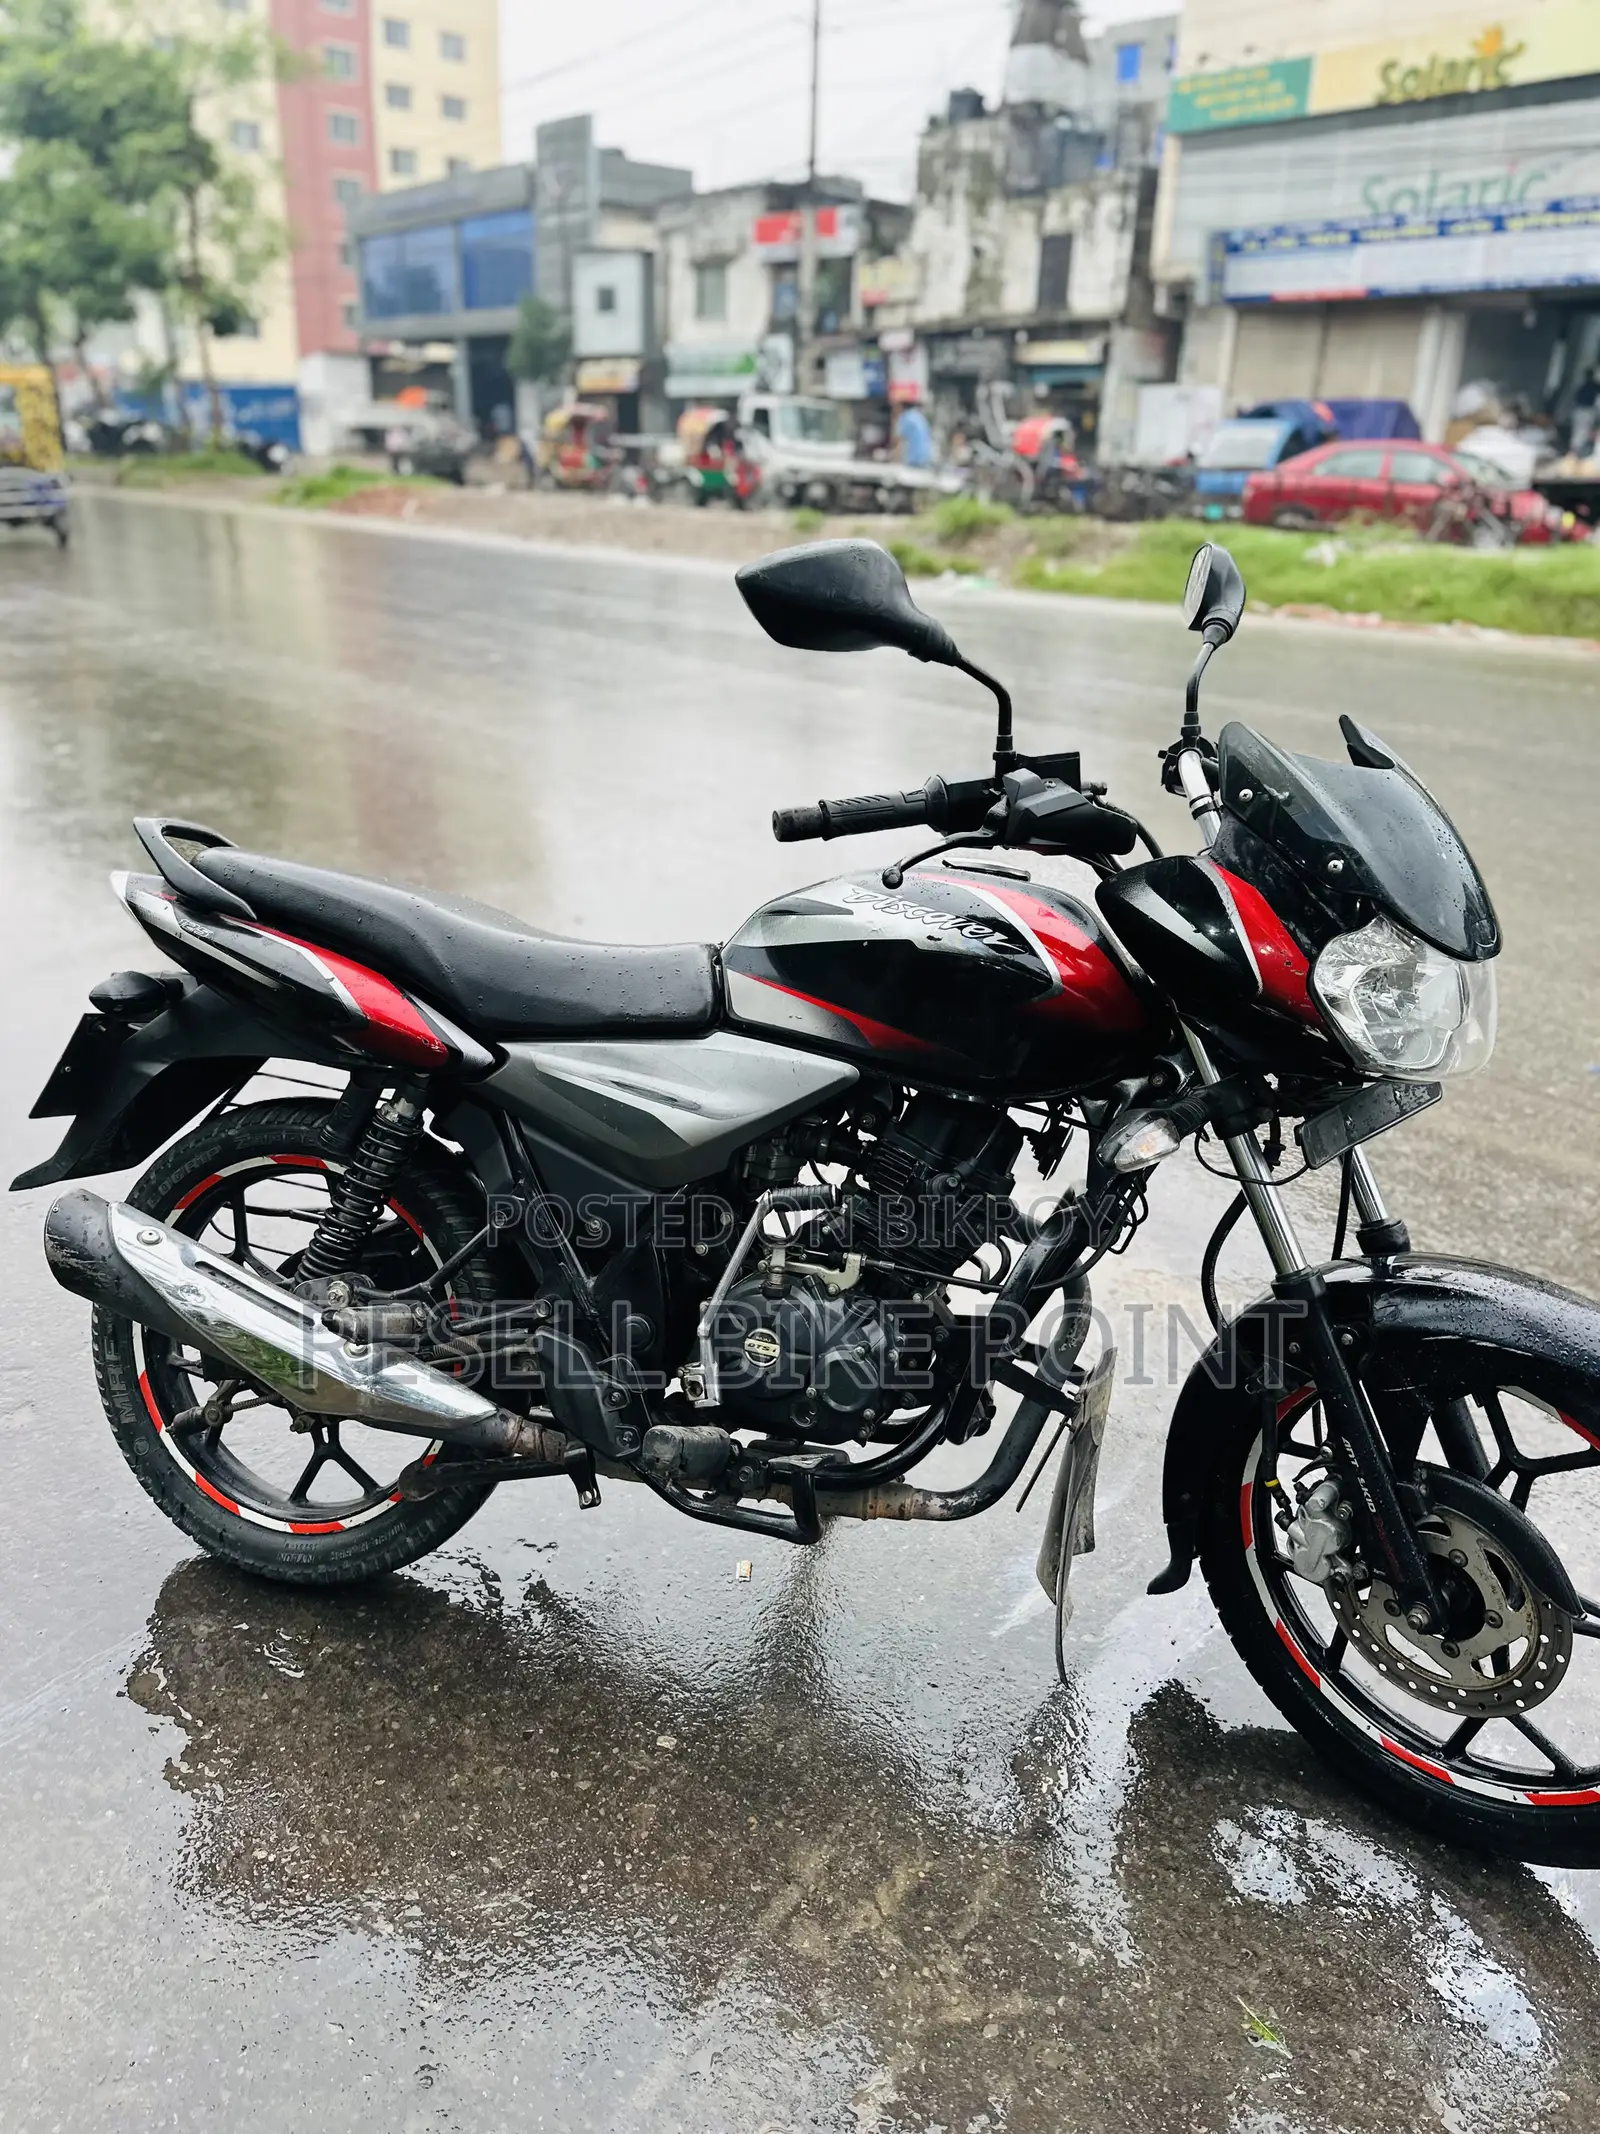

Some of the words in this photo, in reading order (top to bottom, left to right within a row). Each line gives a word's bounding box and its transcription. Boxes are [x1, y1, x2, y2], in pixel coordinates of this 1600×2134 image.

[842, 884, 1029, 955] Discover
[104, 1336, 136, 1424] MRF
[1357, 1476, 1377, 1513] SKID
